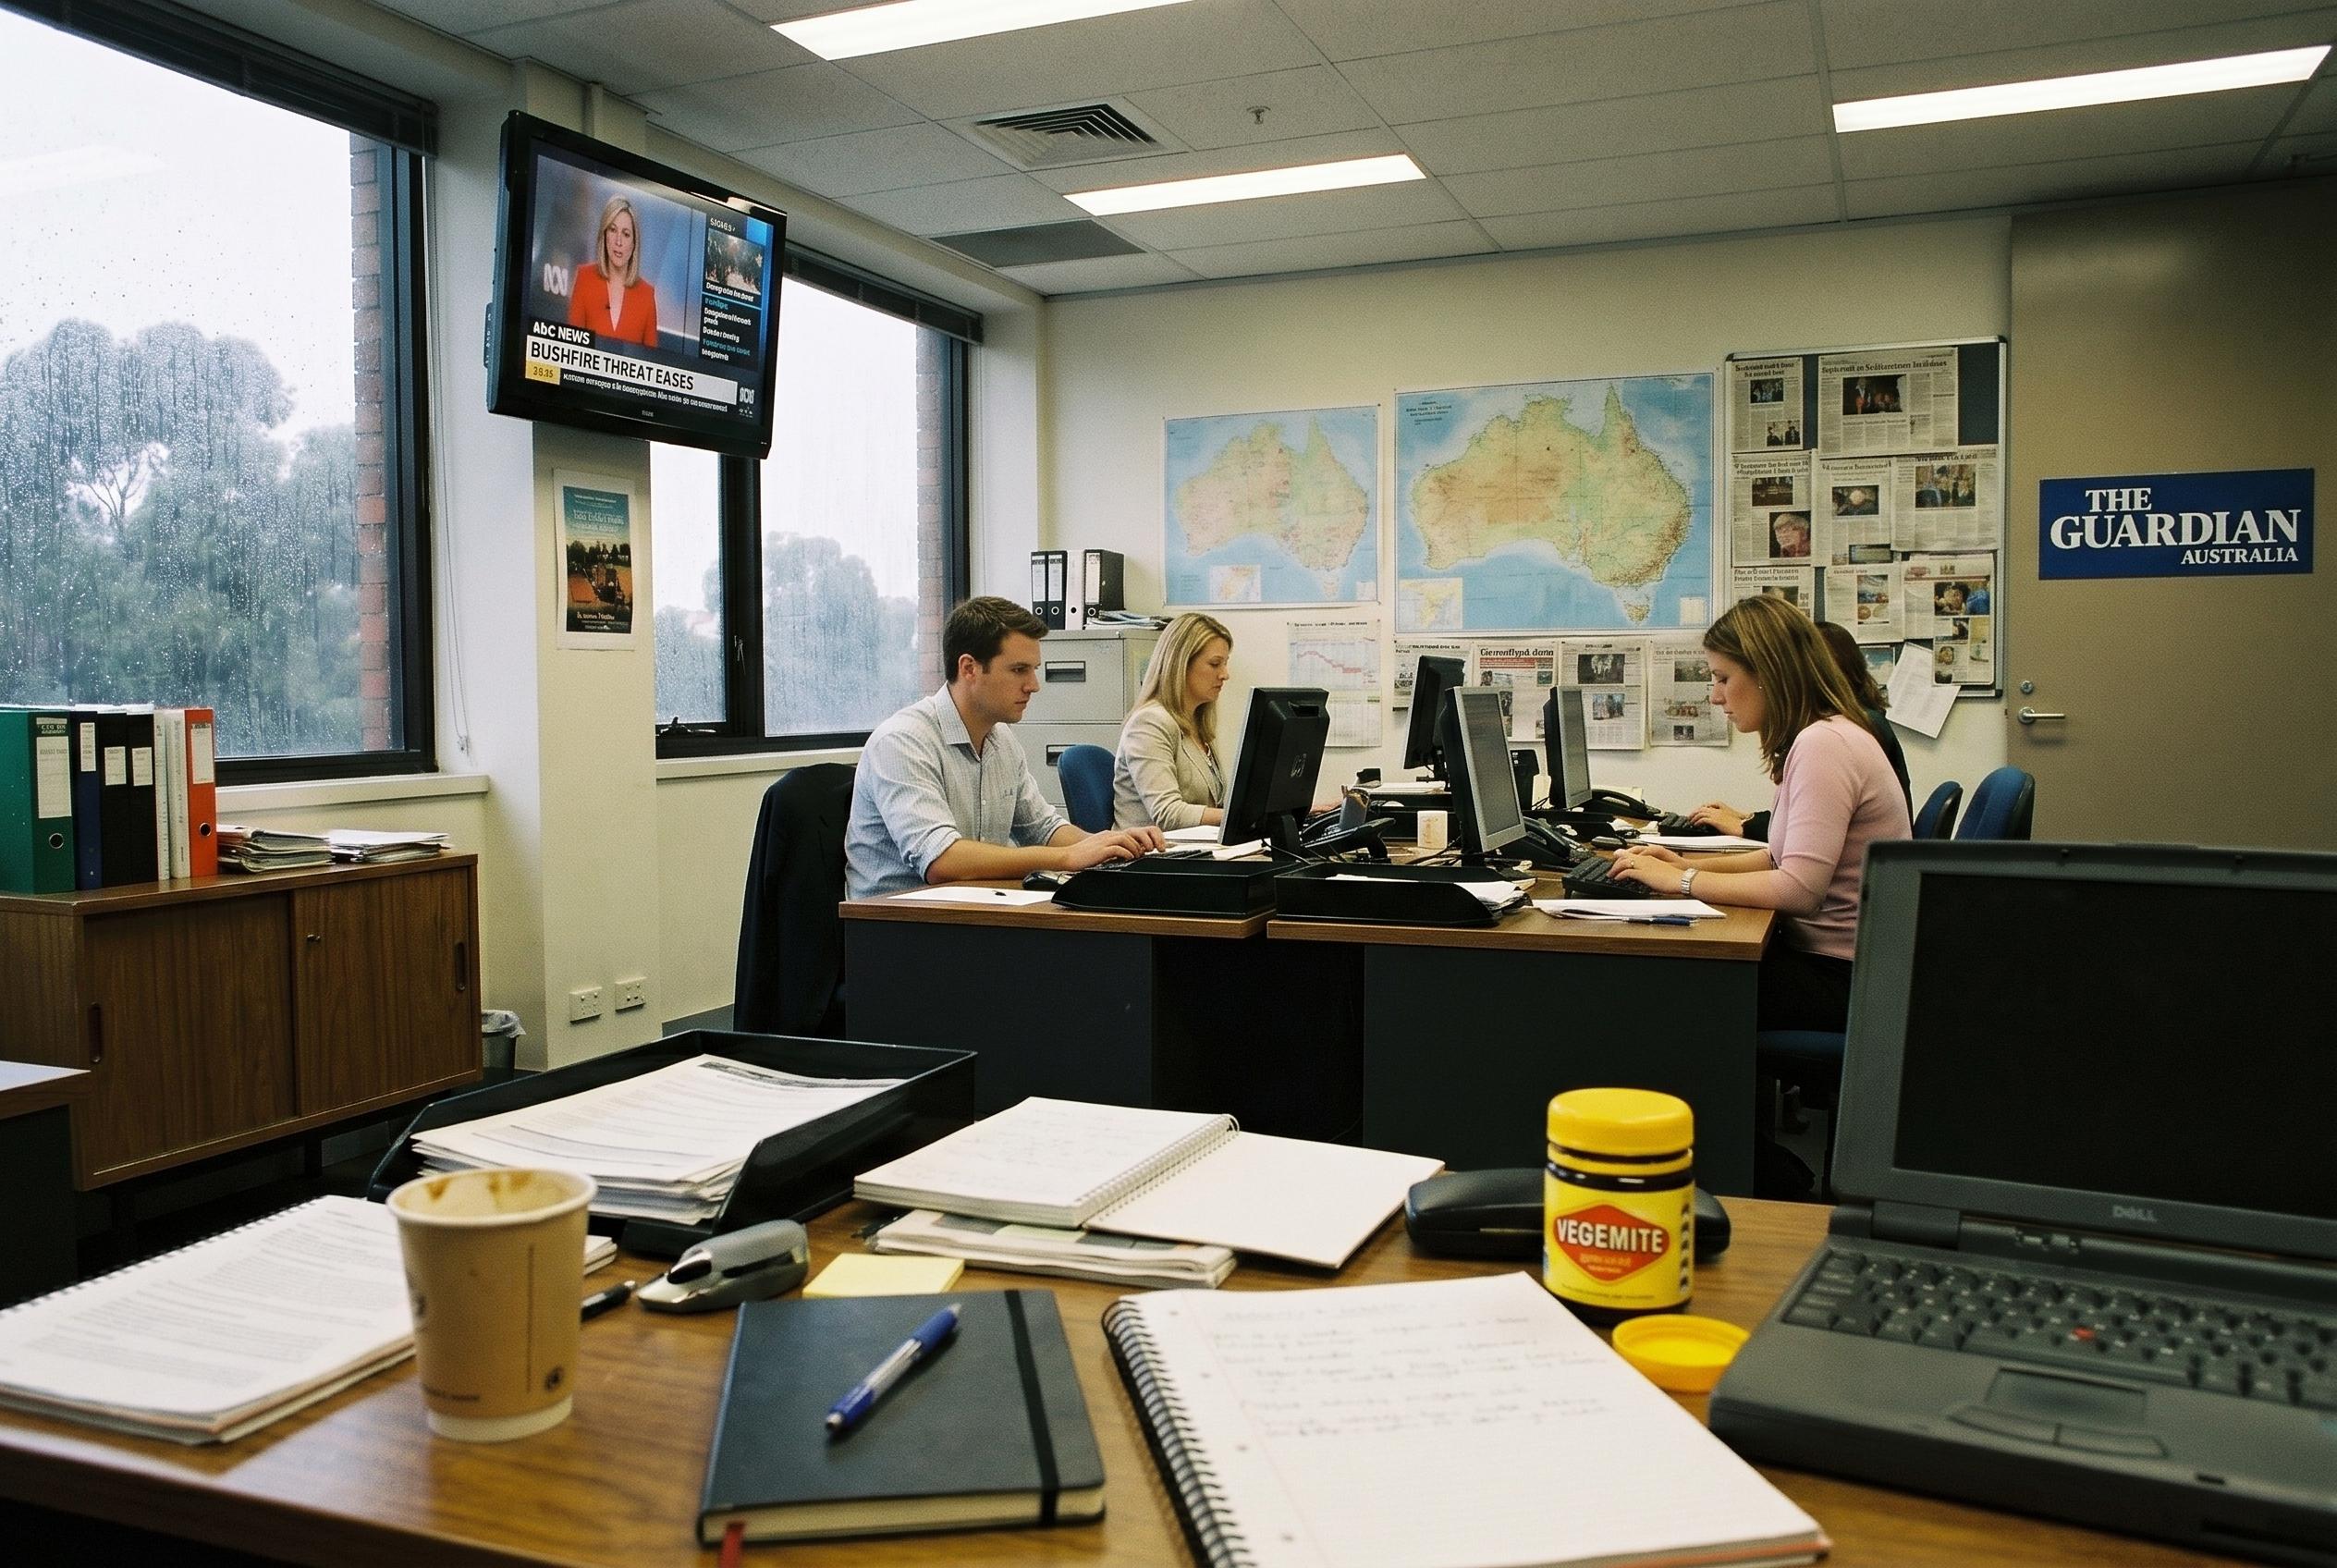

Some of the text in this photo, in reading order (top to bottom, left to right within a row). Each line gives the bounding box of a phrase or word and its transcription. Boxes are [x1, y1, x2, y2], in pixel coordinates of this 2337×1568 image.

[557, 326, 590, 345] NEWS
[531, 341, 694, 391] BUSHFIRE THREAT EASES
[2086, 487, 2152, 513] THE
[2049, 508, 2302, 549] GUARDIAN
[2180, 546, 2299, 565] AUSTRALIA
[1556, 1219, 1664, 1254] VEGEMITE
